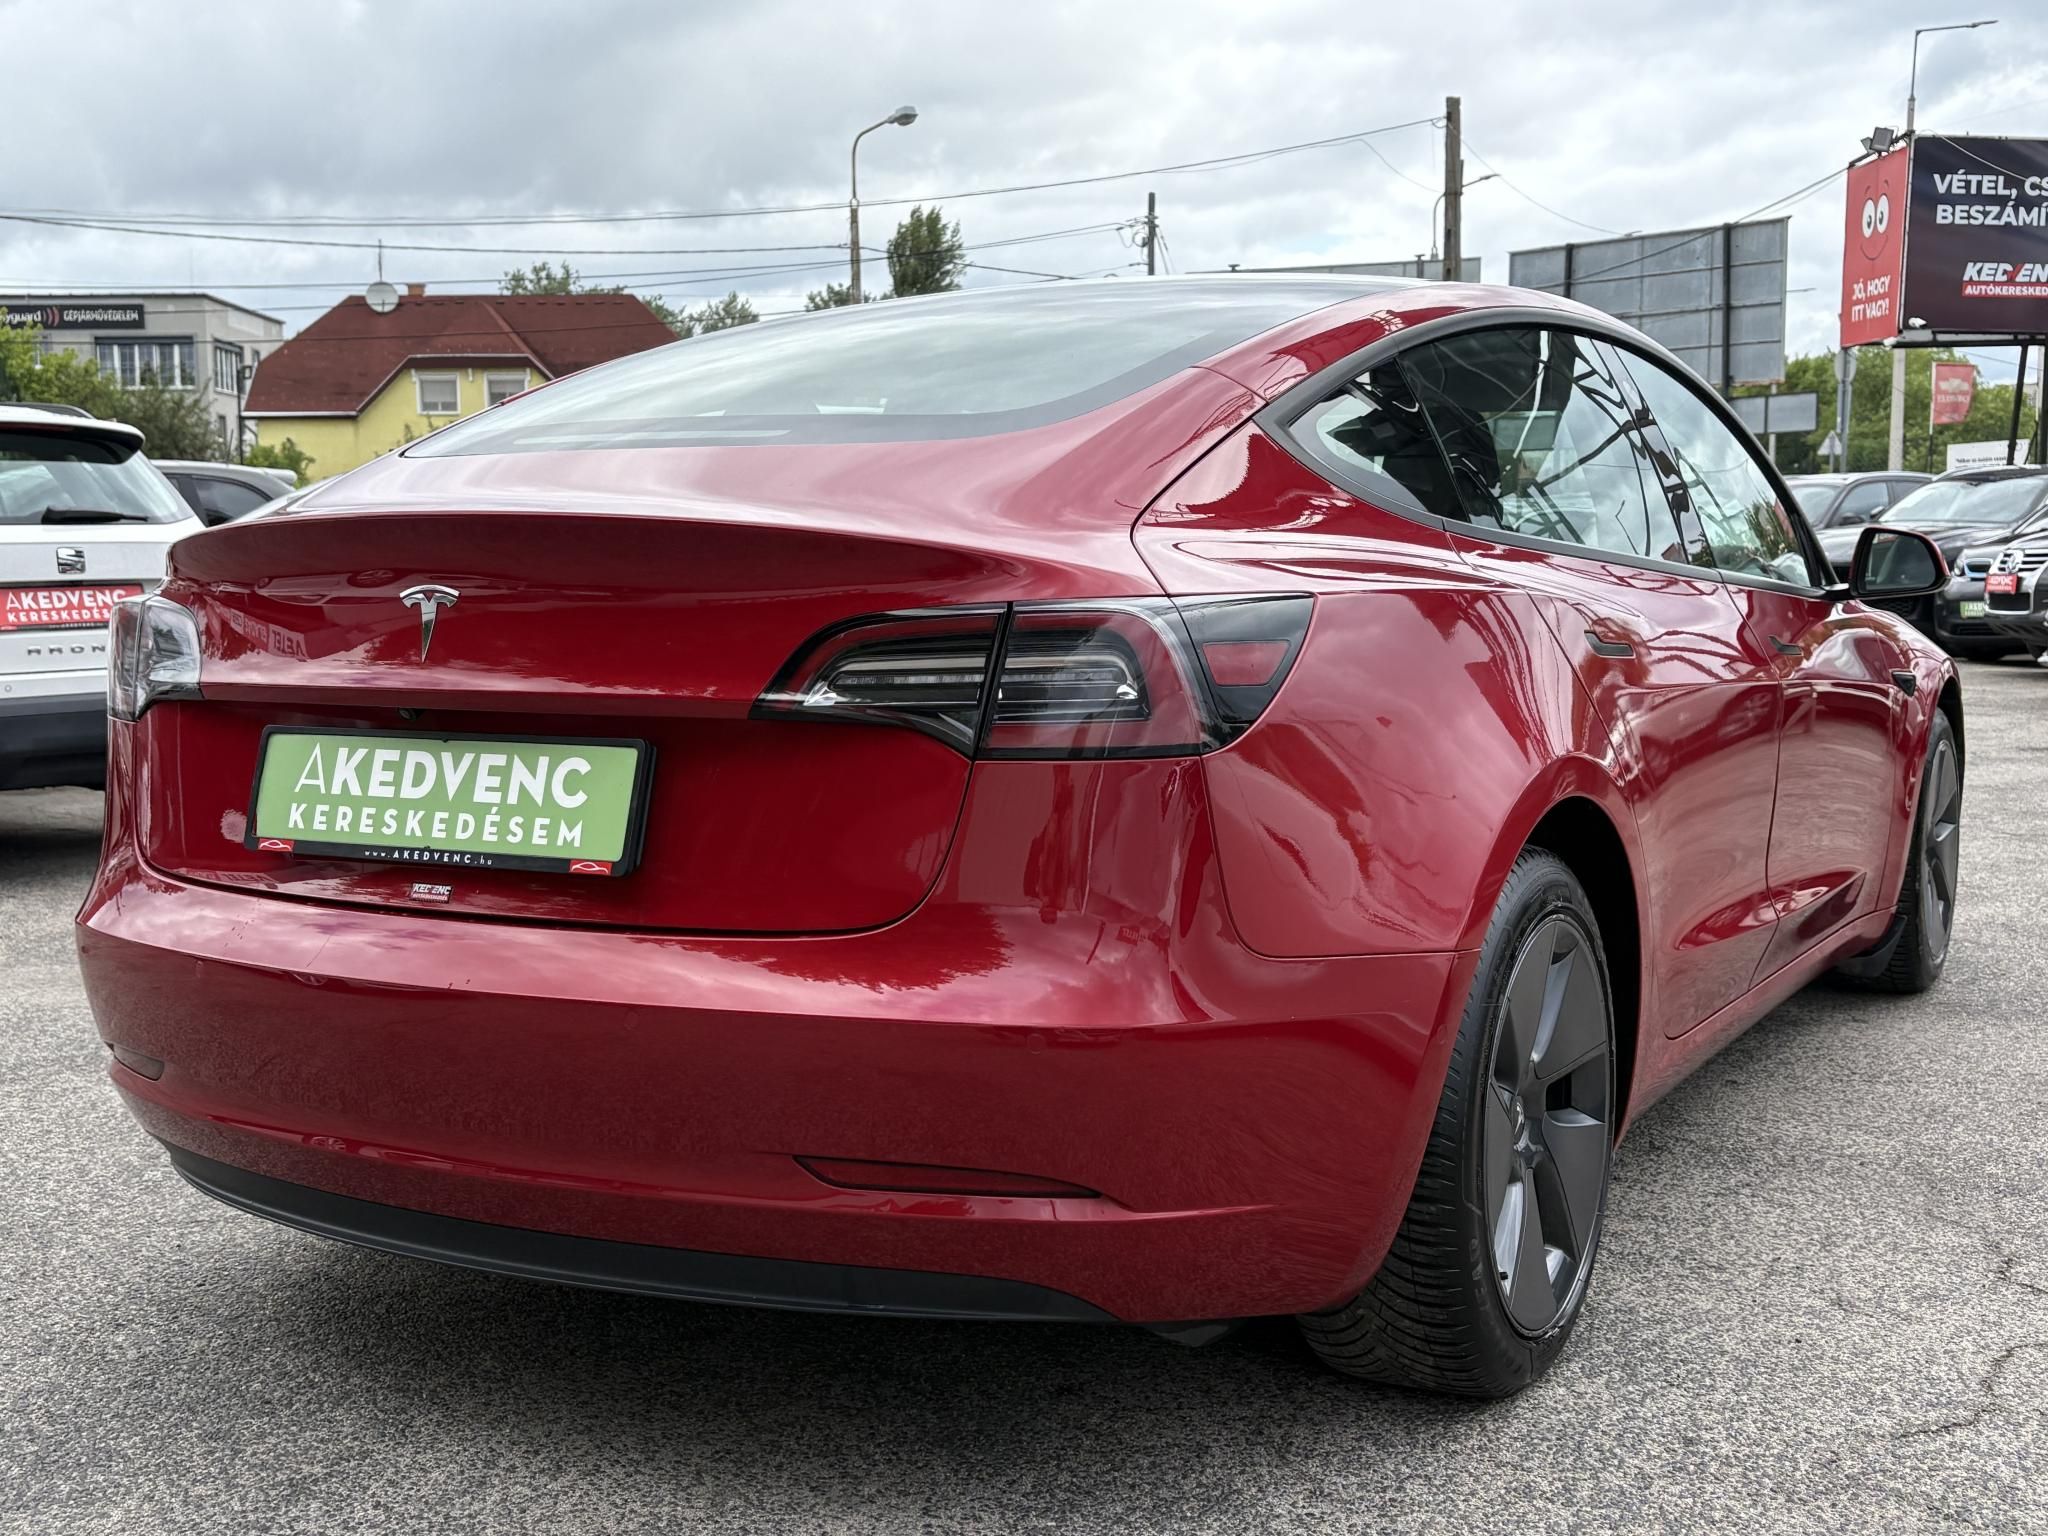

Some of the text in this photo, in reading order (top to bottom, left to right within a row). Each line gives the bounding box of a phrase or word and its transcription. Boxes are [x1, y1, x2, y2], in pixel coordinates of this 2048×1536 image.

[1933, 169, 2018, 200] VÉTEL,
[1936, 200, 2048, 227] BESZÁMÍ
[1852, 274, 1891, 301] JÓ, HOGY
[0, 311, 41, 324] yguard
[1851, 297, 1890, 322] ITT VAGY!
[288, 803, 584, 848] KERESKEDÉSEM
